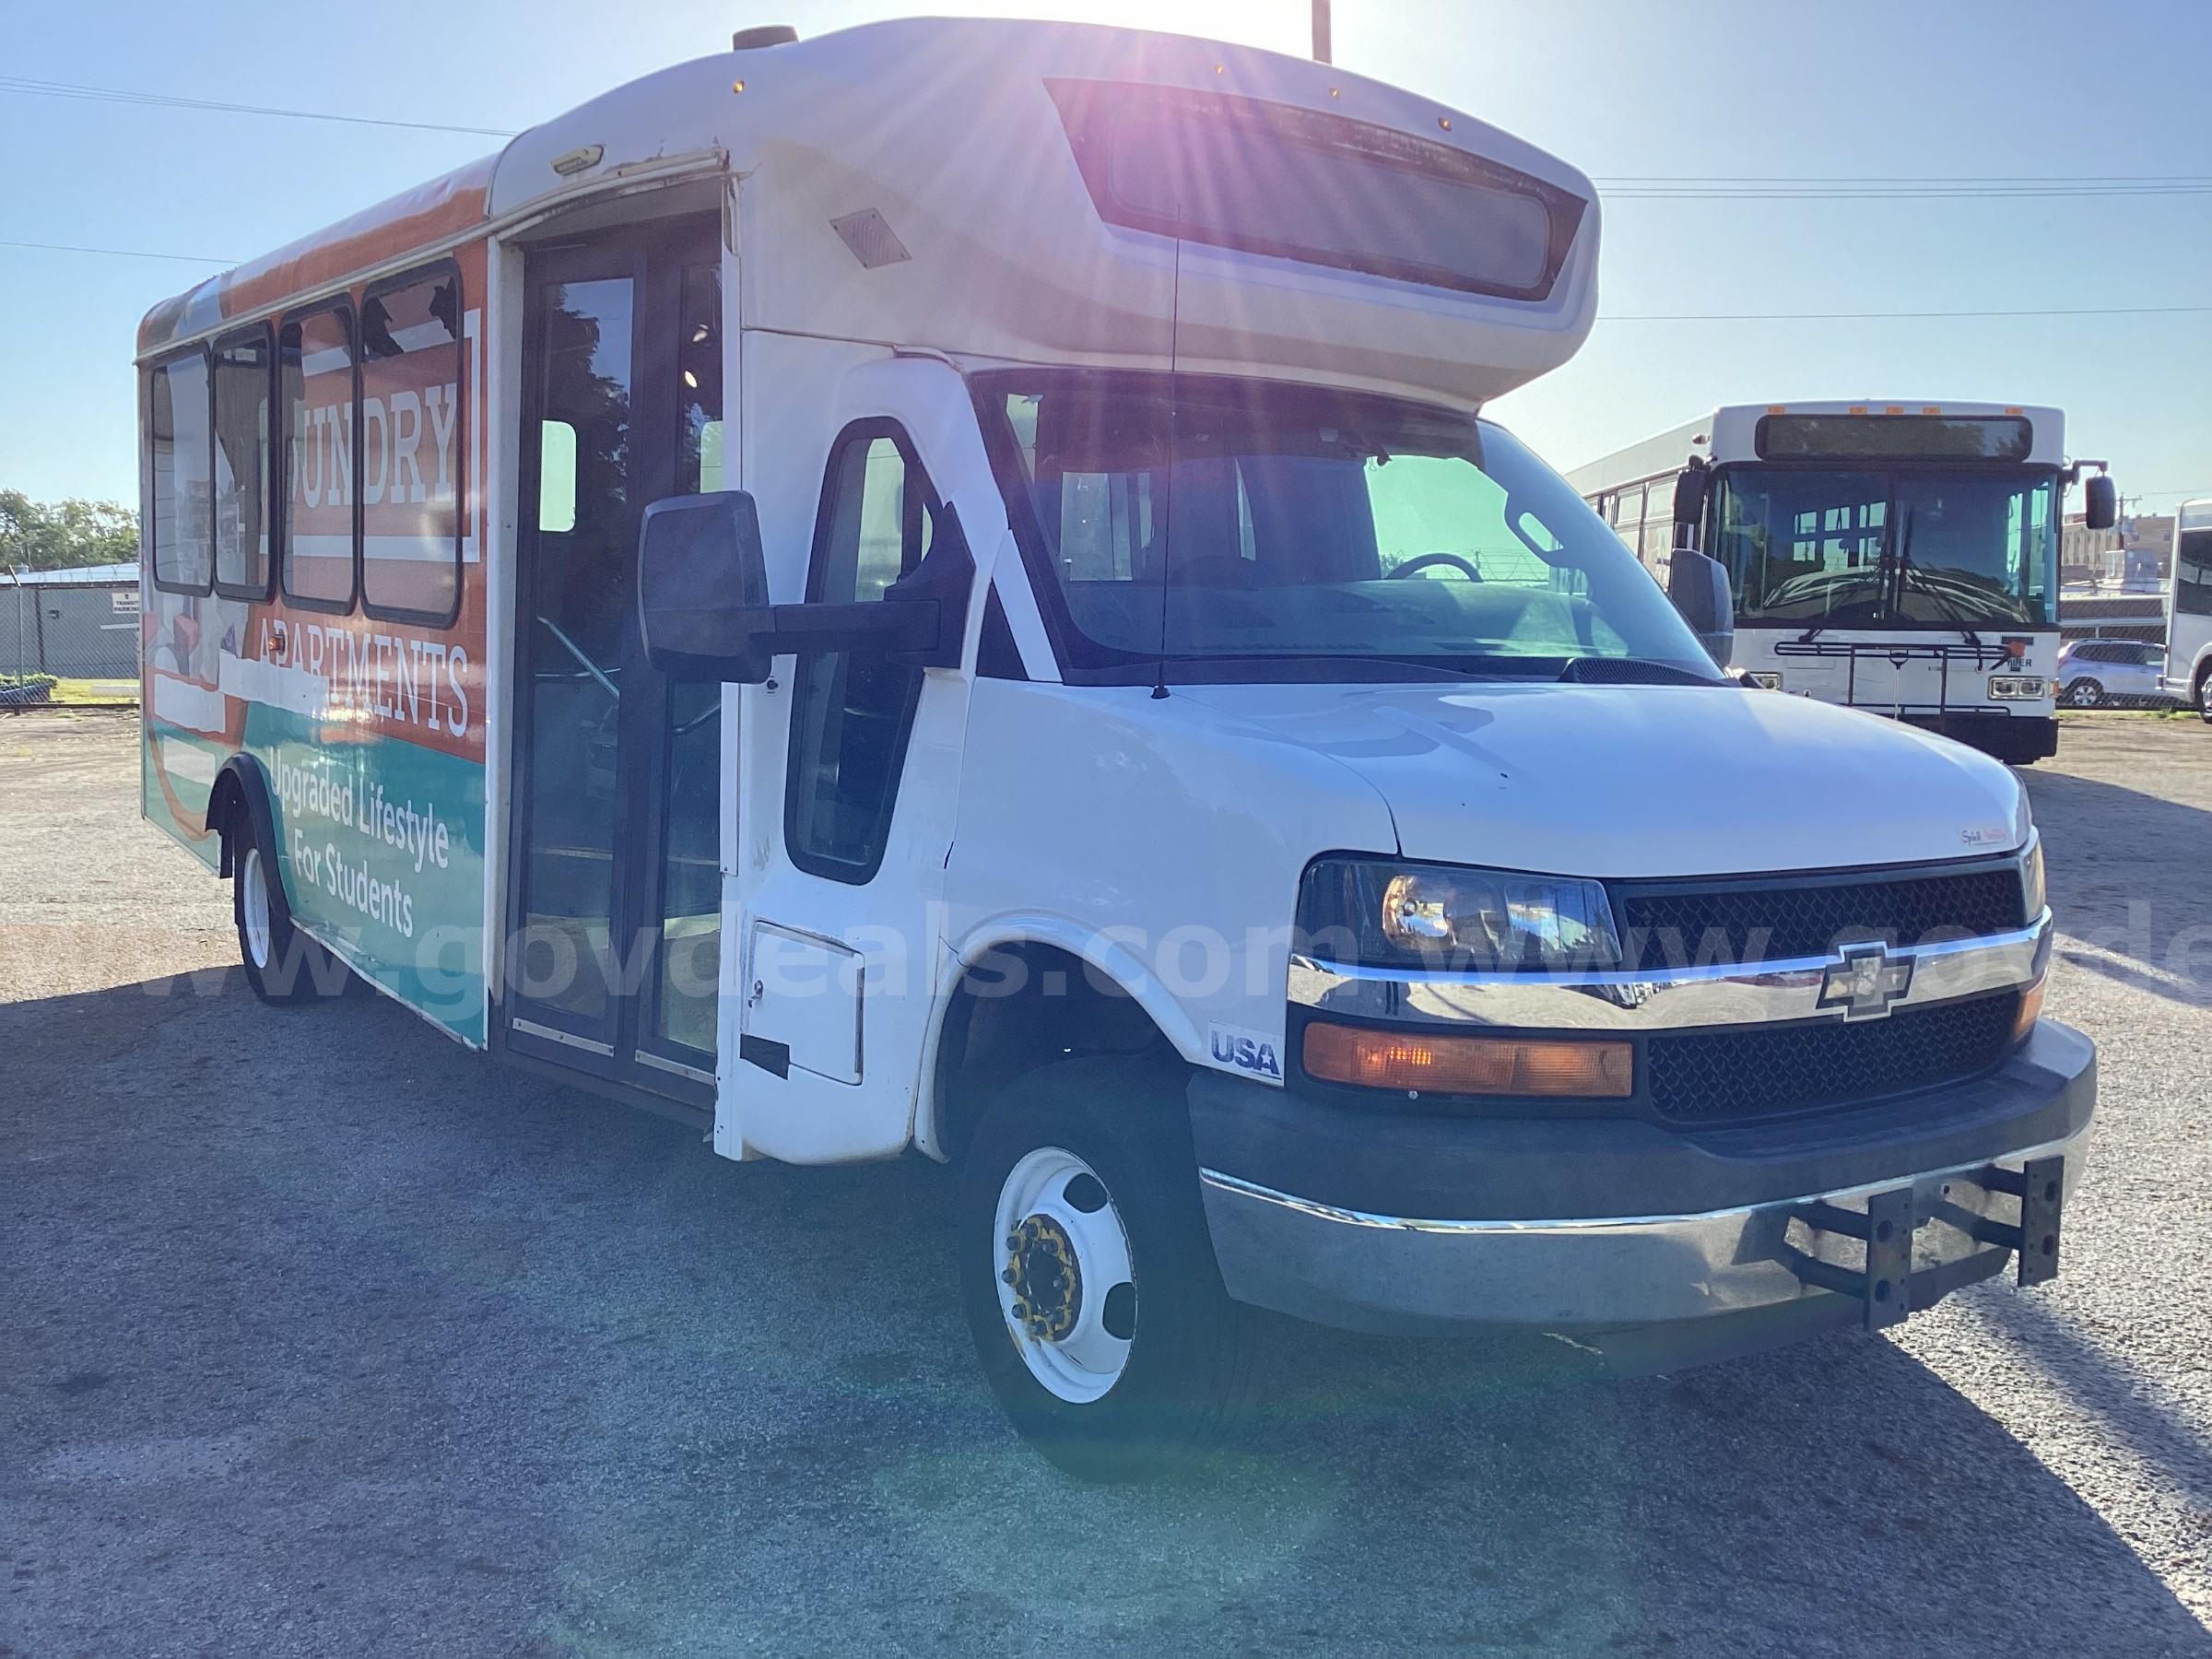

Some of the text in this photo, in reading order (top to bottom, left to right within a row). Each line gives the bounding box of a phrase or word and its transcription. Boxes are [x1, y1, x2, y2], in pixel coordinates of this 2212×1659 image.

[259, 618, 468, 737] APARTMENTS
[270, 747, 449, 874] Upgraded Lifestyle
[294, 828, 413, 938] For Students
[1212, 1031, 1280, 1076] USA
